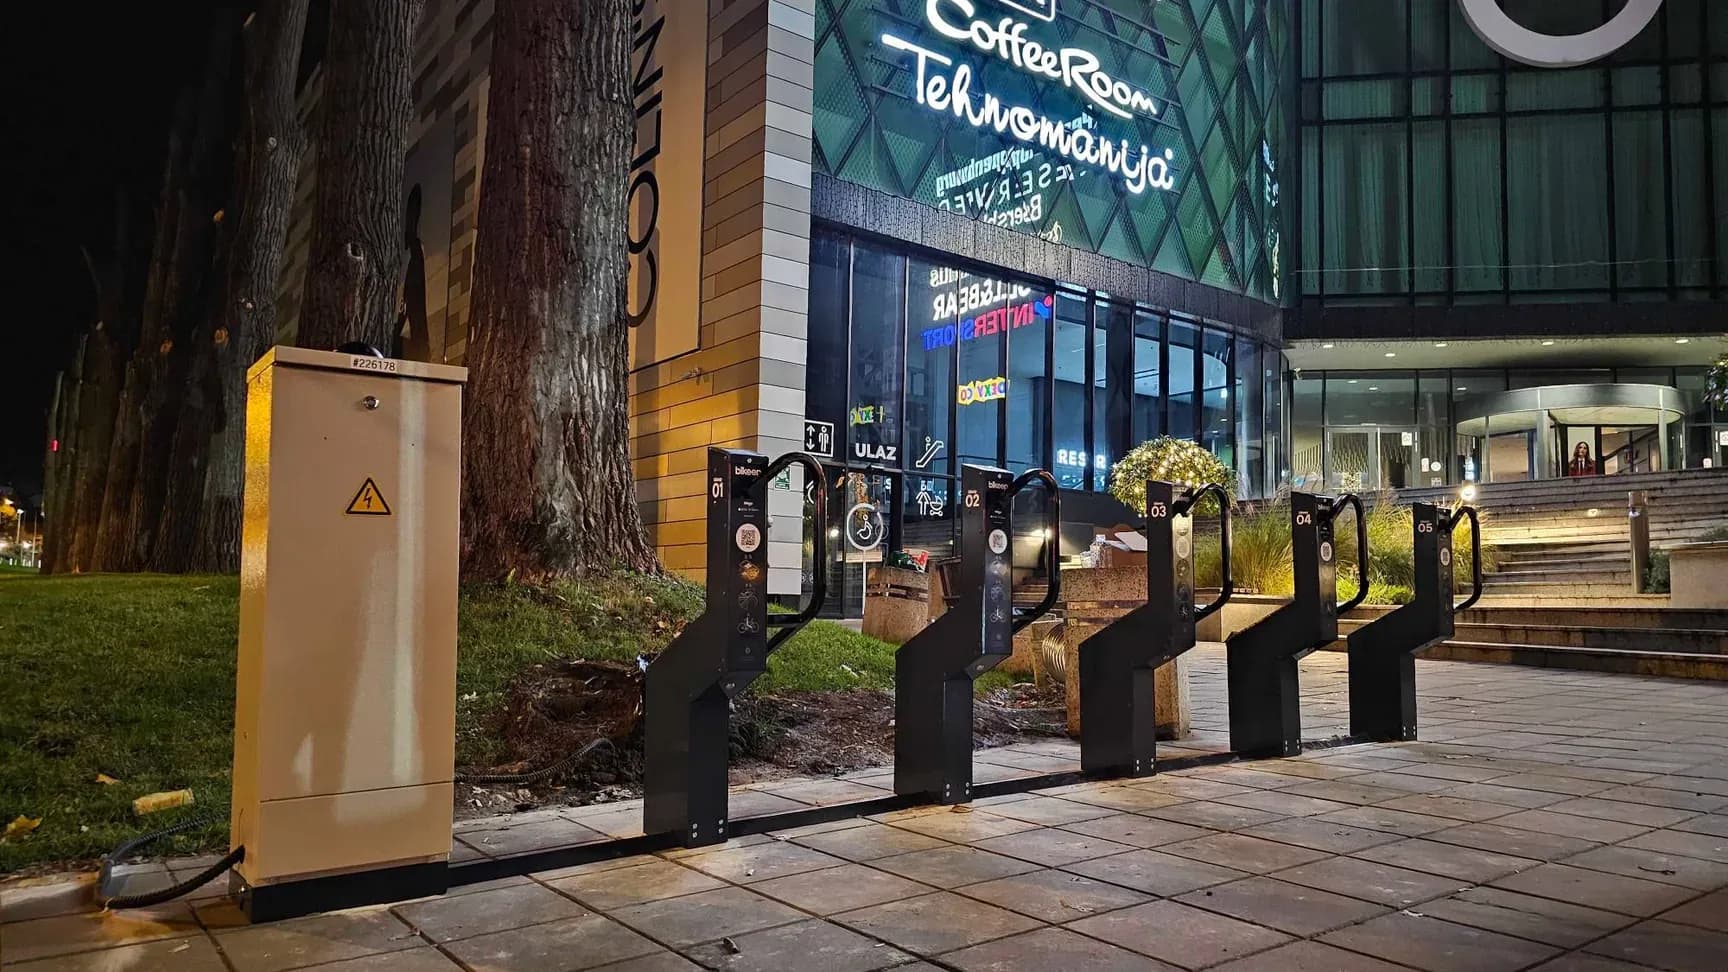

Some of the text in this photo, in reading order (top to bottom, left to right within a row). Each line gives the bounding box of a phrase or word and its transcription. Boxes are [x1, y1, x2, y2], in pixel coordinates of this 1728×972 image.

[882, 34, 1174, 194] Tehnomanija
[353, 358, 396, 371] #226178
[855, 442, 897, 460] ULAZ
[712, 481, 724, 498] 01
[965, 494, 980, 507] 02
[1151, 505, 1167, 518] 03
[1296, 513, 1312, 525] 04
[1418, 523, 1433, 533] 05
